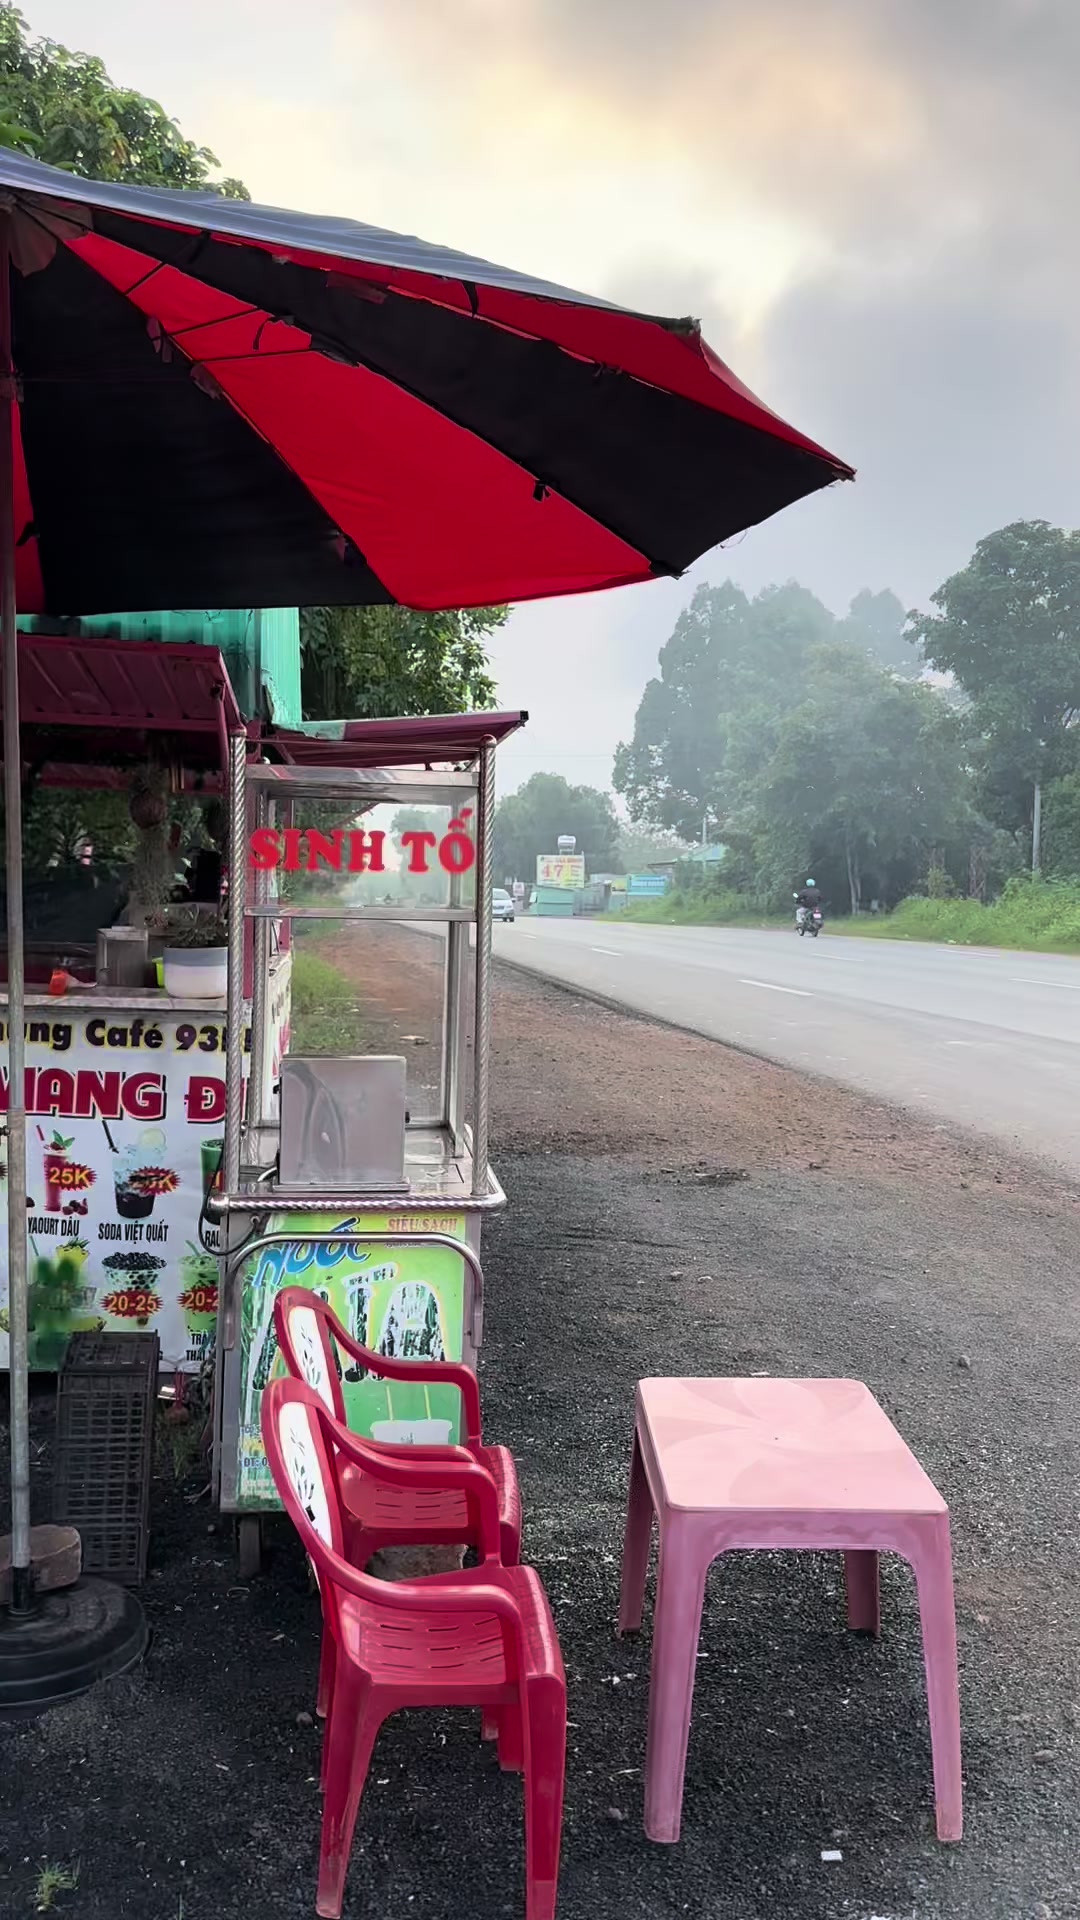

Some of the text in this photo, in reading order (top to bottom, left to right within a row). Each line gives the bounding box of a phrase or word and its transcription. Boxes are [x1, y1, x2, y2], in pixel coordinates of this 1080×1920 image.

[250, 808, 475, 873] SINH TỐ
[86, 1019, 164, 1049] Café
[49, 1167, 91, 1187] 25K
[28, 1217, 59, 1236] YAOURT
[98, 1222, 121, 1241] SODA
[124, 1220, 144, 1245] VIỆT
[107, 1295, 158, 1312] 20-25
[185, 1291, 219, 1308] 20-2
